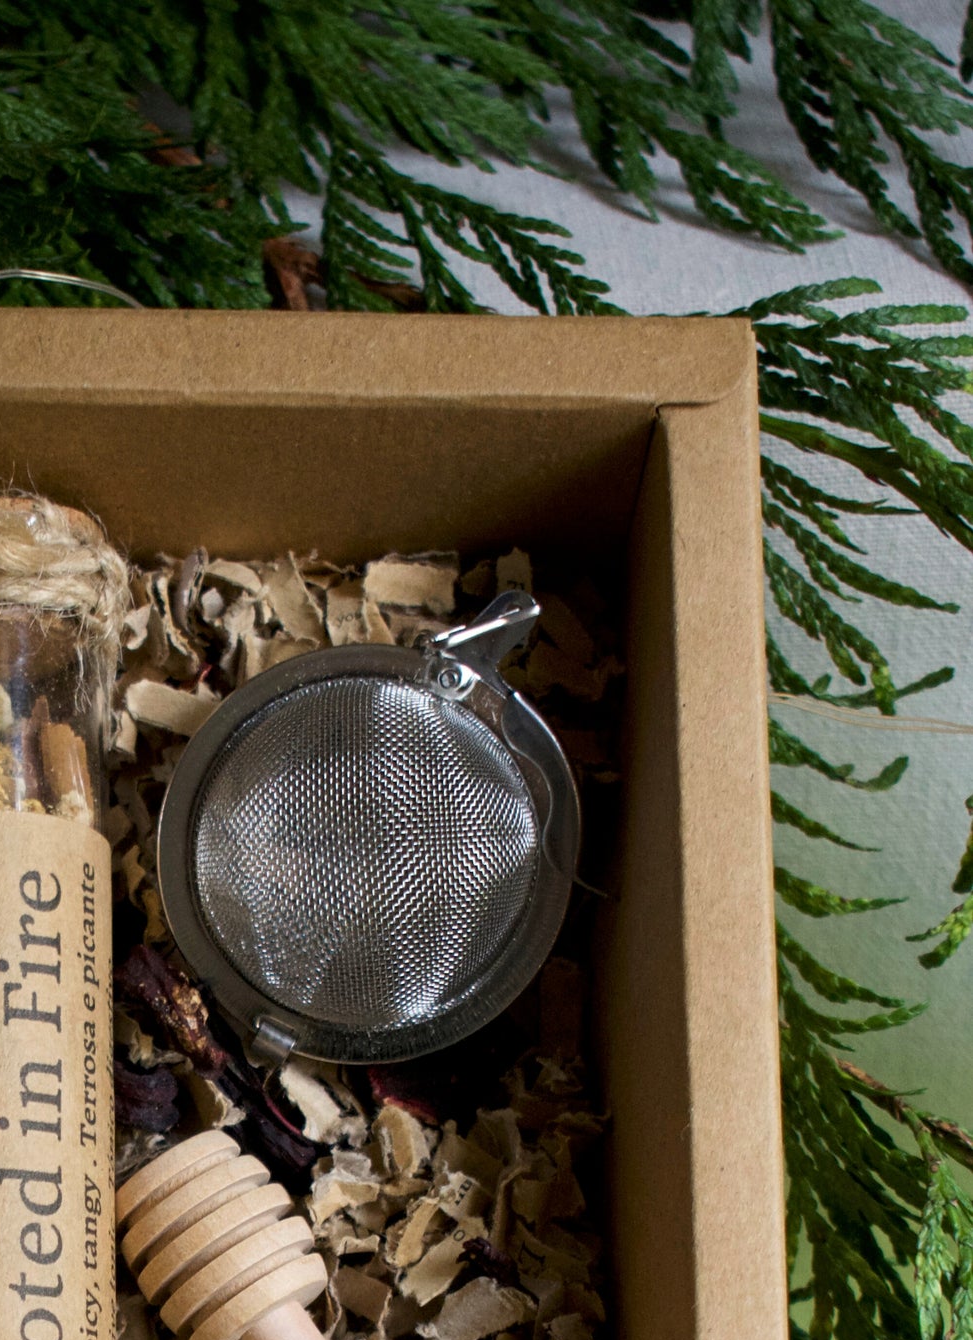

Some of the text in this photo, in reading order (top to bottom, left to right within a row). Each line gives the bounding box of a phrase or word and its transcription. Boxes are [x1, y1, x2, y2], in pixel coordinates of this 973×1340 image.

[77, 862, 100, 988] picante
[82, 993, 96, 1012] e
[80, 1021, 97, 1148] Terrosa
[83, 1173, 102, 1270] tangy
